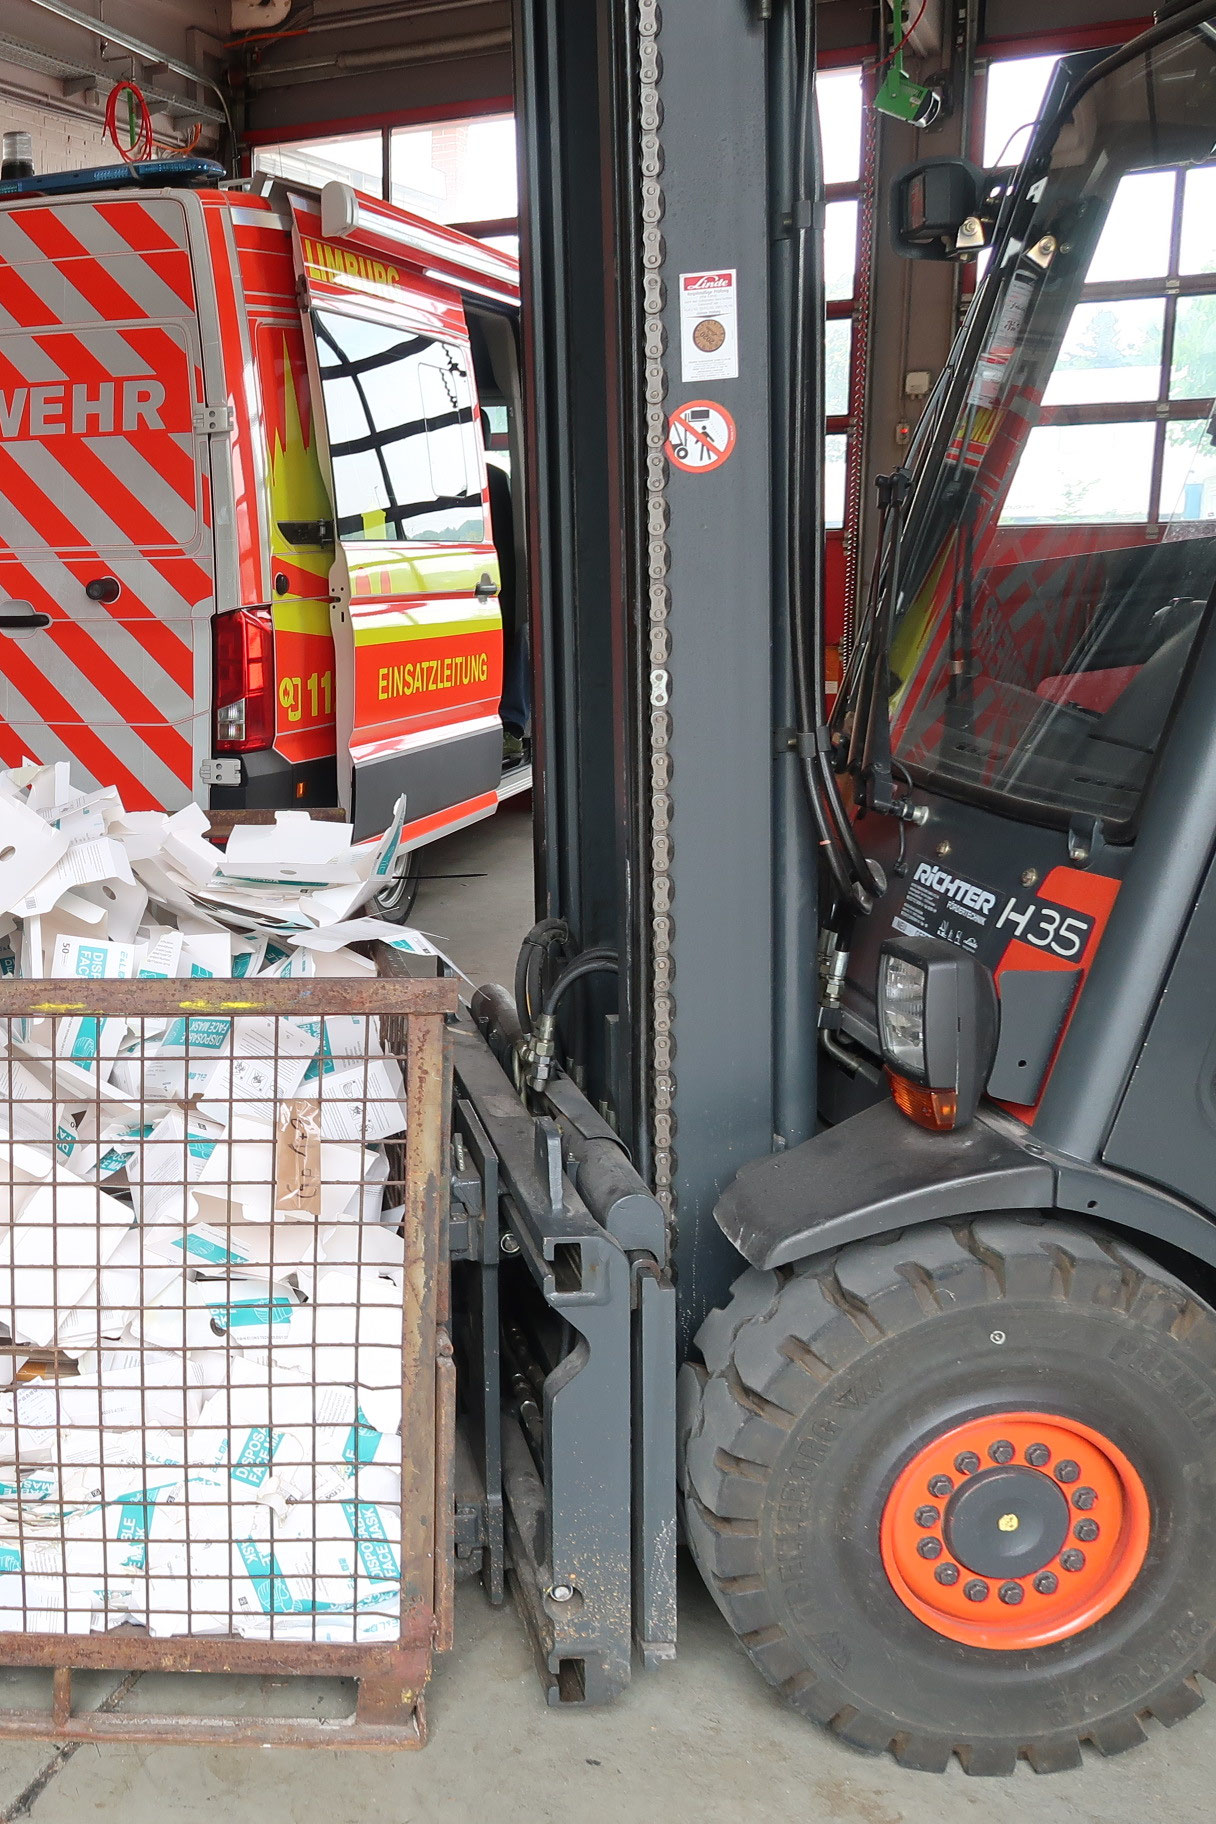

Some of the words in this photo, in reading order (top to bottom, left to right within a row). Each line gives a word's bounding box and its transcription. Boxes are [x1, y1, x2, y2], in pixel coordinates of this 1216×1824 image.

[687, 274, 729, 290] Linde
[307, 669, 333, 717] 11
[378, 652, 489, 701] EINSATZLEITUNG
[61, 942, 71, 955] 50
[995, 897, 1088, 957] H35
